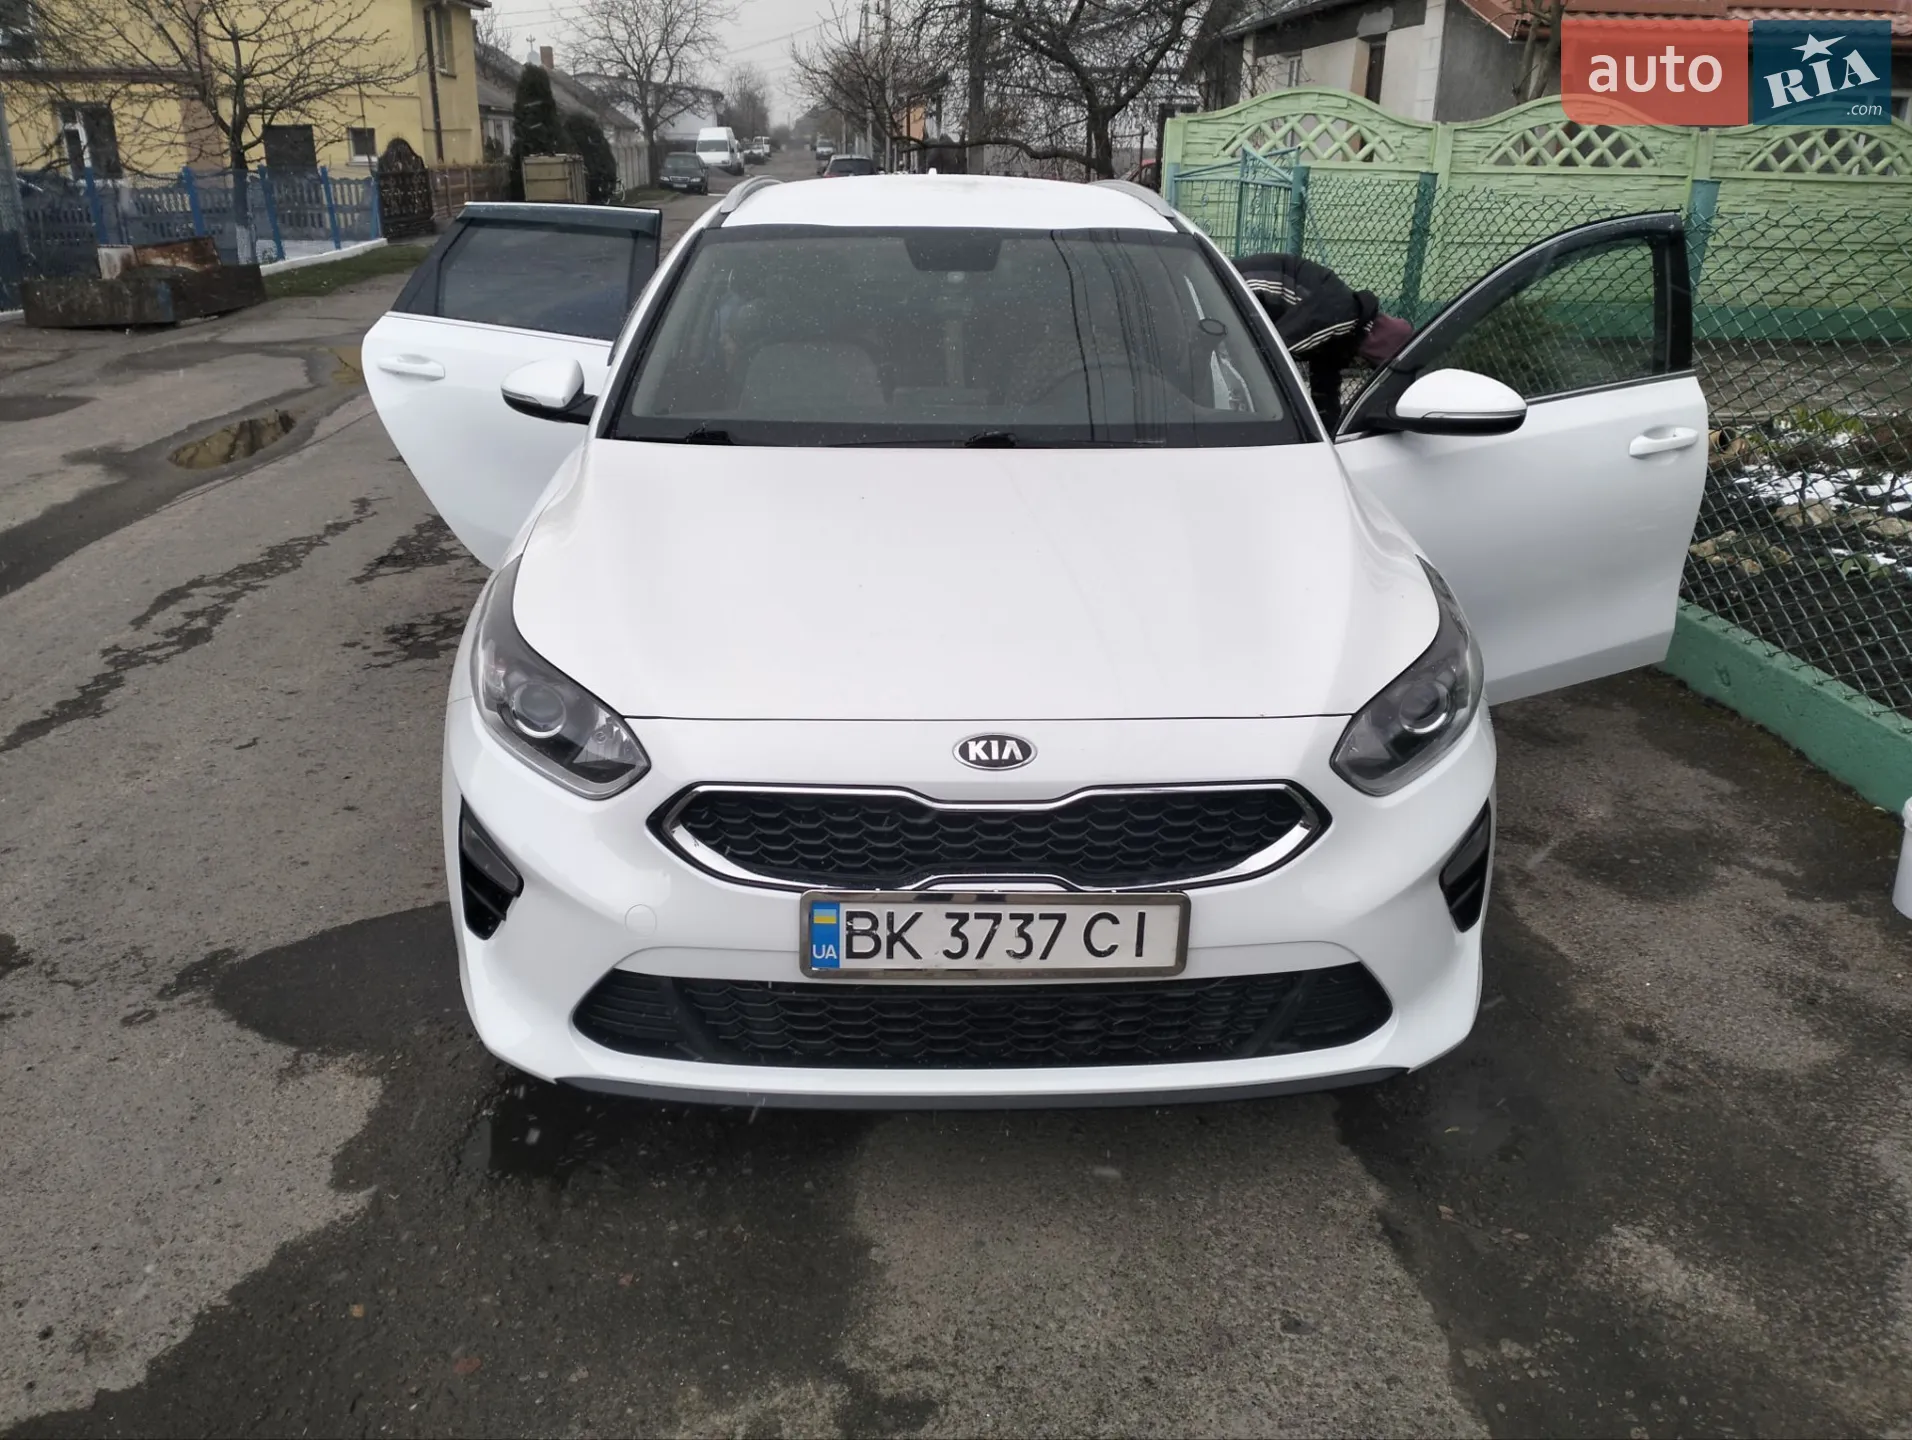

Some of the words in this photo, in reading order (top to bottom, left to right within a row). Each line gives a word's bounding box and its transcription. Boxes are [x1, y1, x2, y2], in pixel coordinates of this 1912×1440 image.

[967, 740, 1023, 761] KIA
[845, 911, 924, 960] BK
[942, 912, 1067, 960] 3737
[1083, 911, 1146, 958] CI
[812, 944, 838, 960] UA
